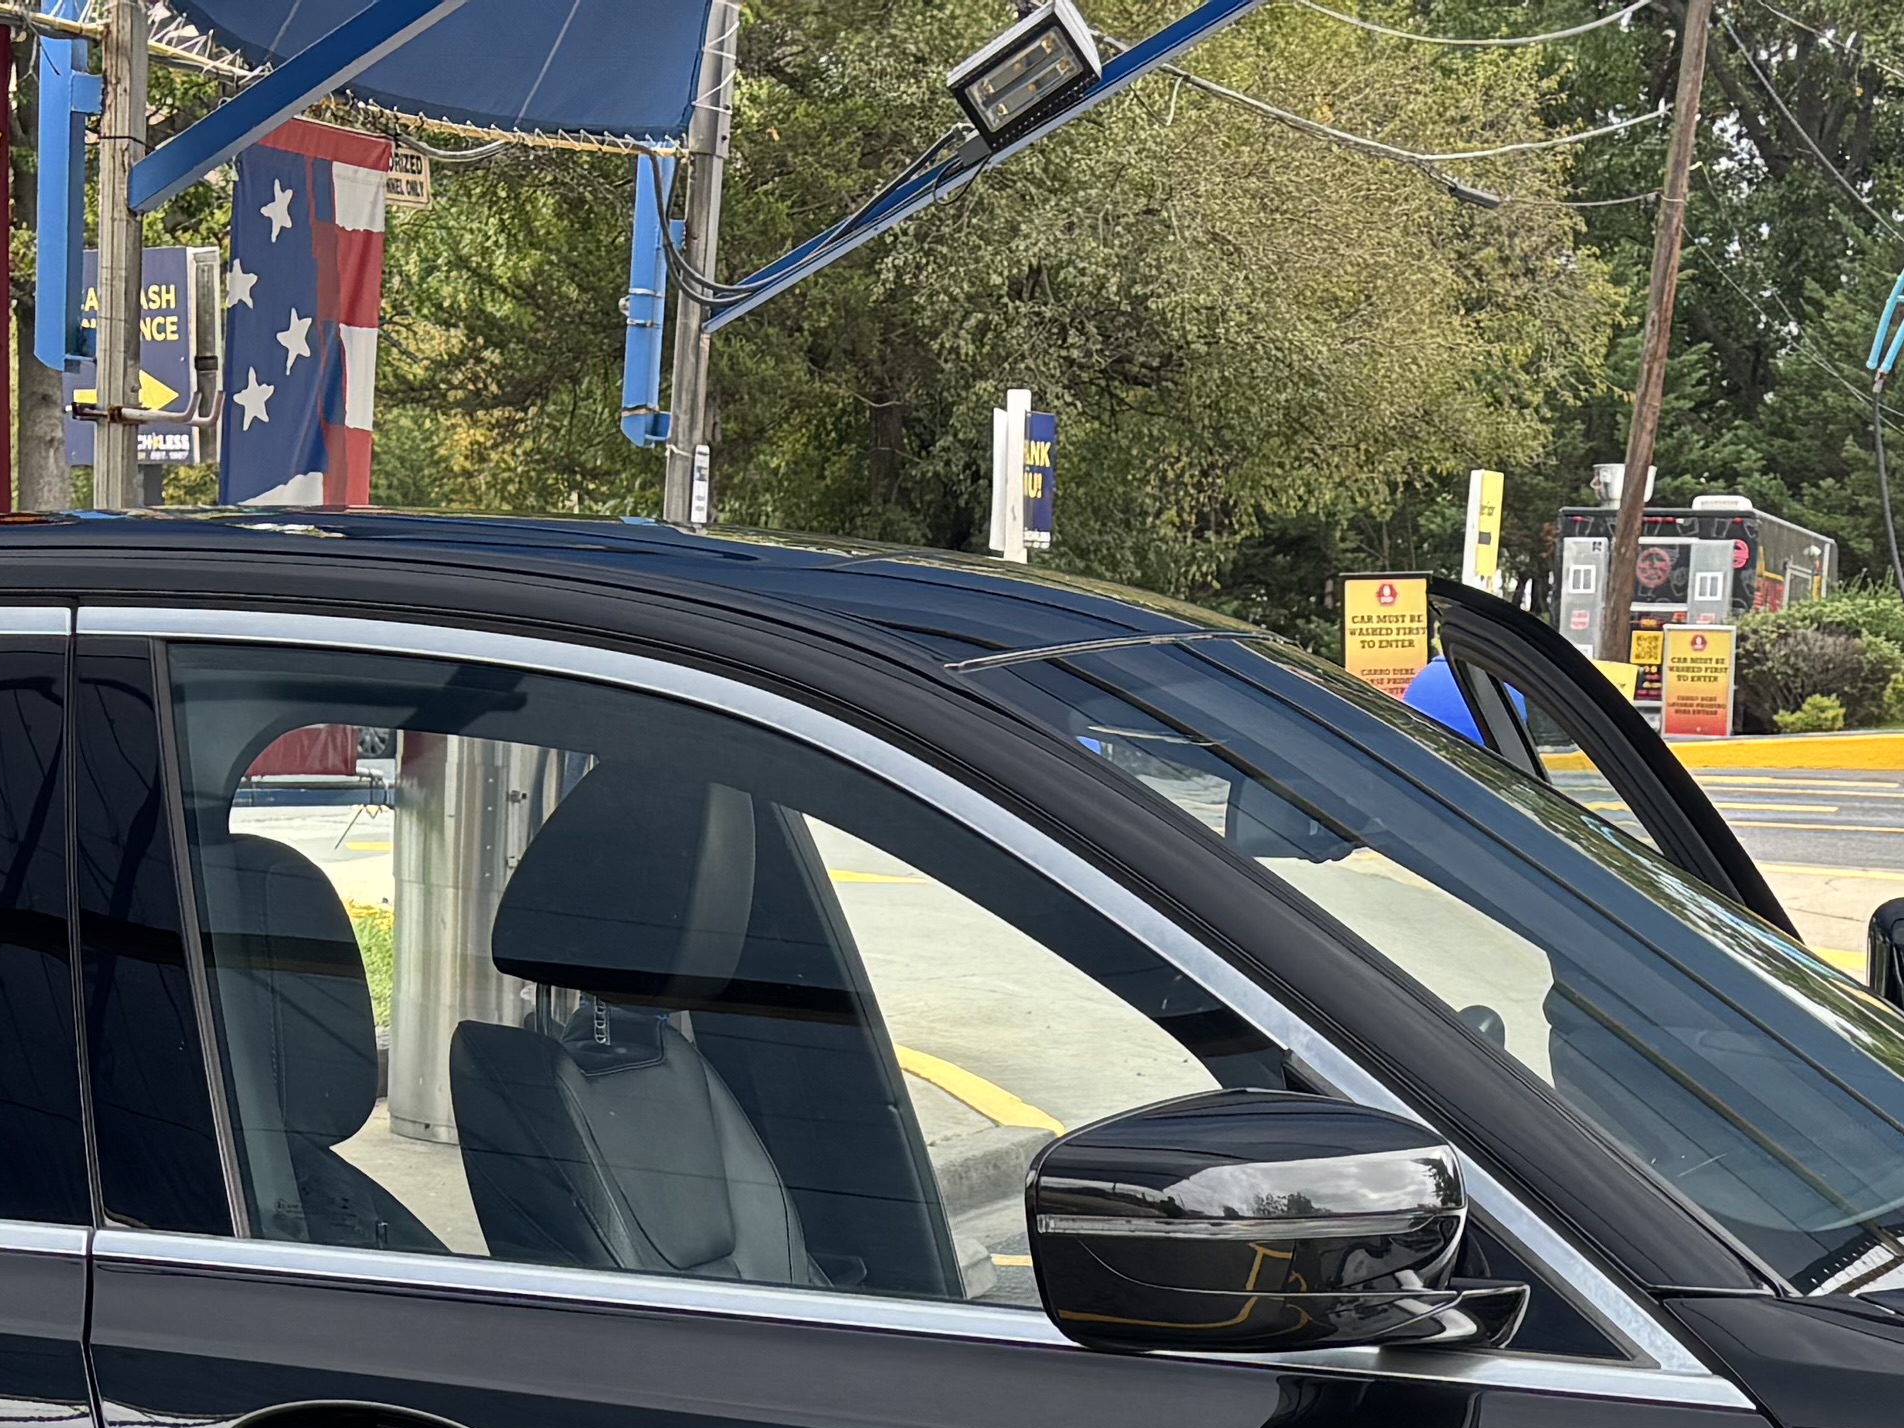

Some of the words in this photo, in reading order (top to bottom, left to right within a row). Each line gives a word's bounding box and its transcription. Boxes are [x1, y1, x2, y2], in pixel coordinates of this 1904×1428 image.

[1351, 615, 1373, 624] CAR
[1376, 614, 1406, 623] MUST
[1410, 614, 1423, 623] BE
[1348, 627, 1393, 636] WASHED
[1396, 627, 1427, 636] FIRST
[1360, 640, 1375, 649] TO
[1378, 639, 1415, 649] ENTER
